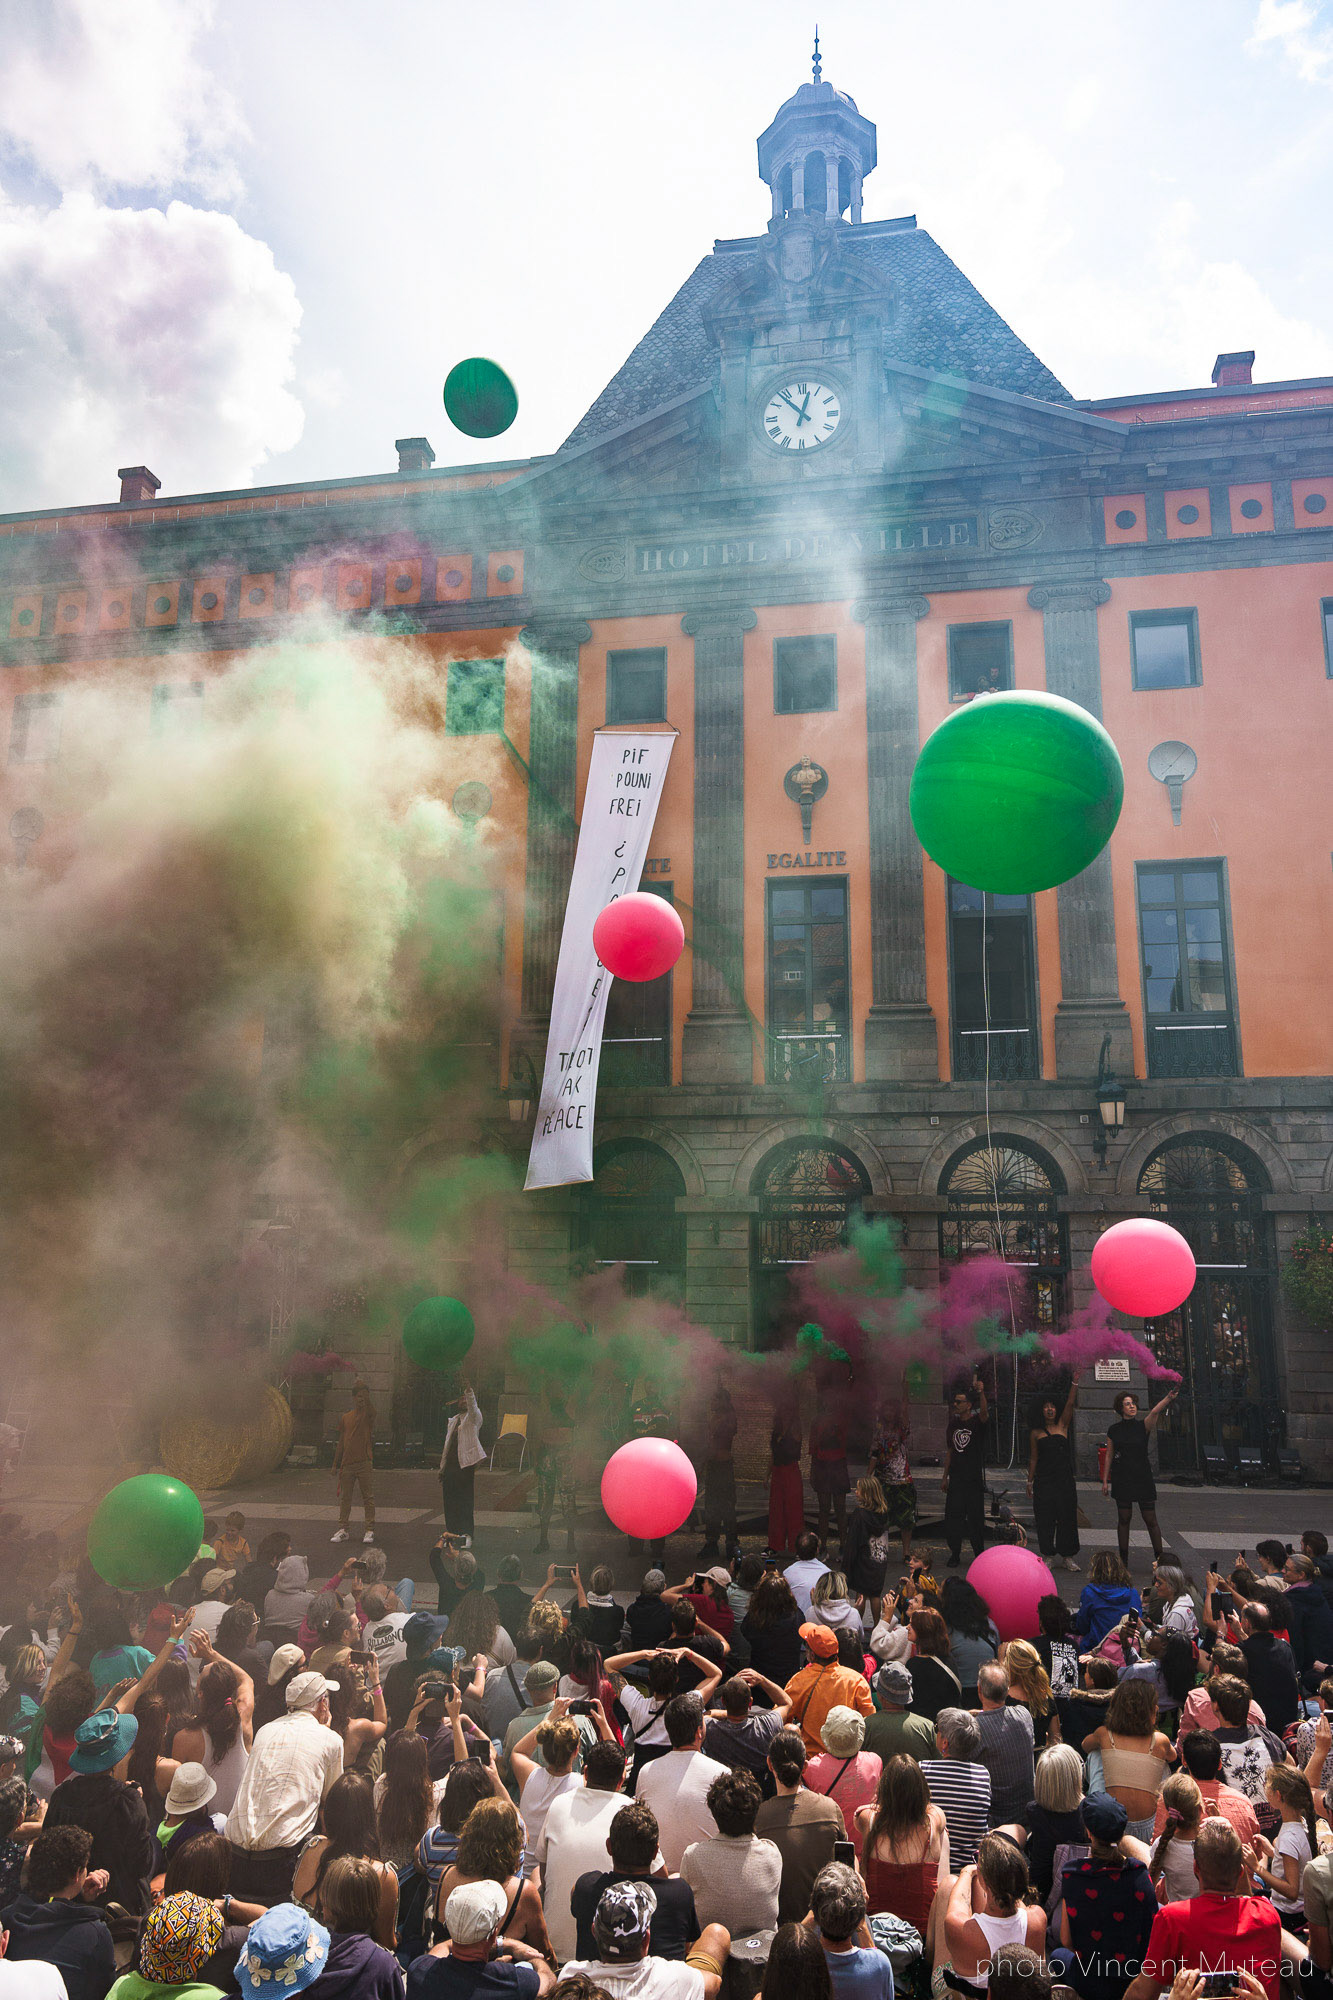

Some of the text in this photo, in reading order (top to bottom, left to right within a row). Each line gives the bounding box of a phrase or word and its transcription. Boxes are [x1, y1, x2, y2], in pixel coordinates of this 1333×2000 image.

[641, 522, 971, 572] HOTEL DE VILLE
[766, 850, 848, 869] EGALITE
